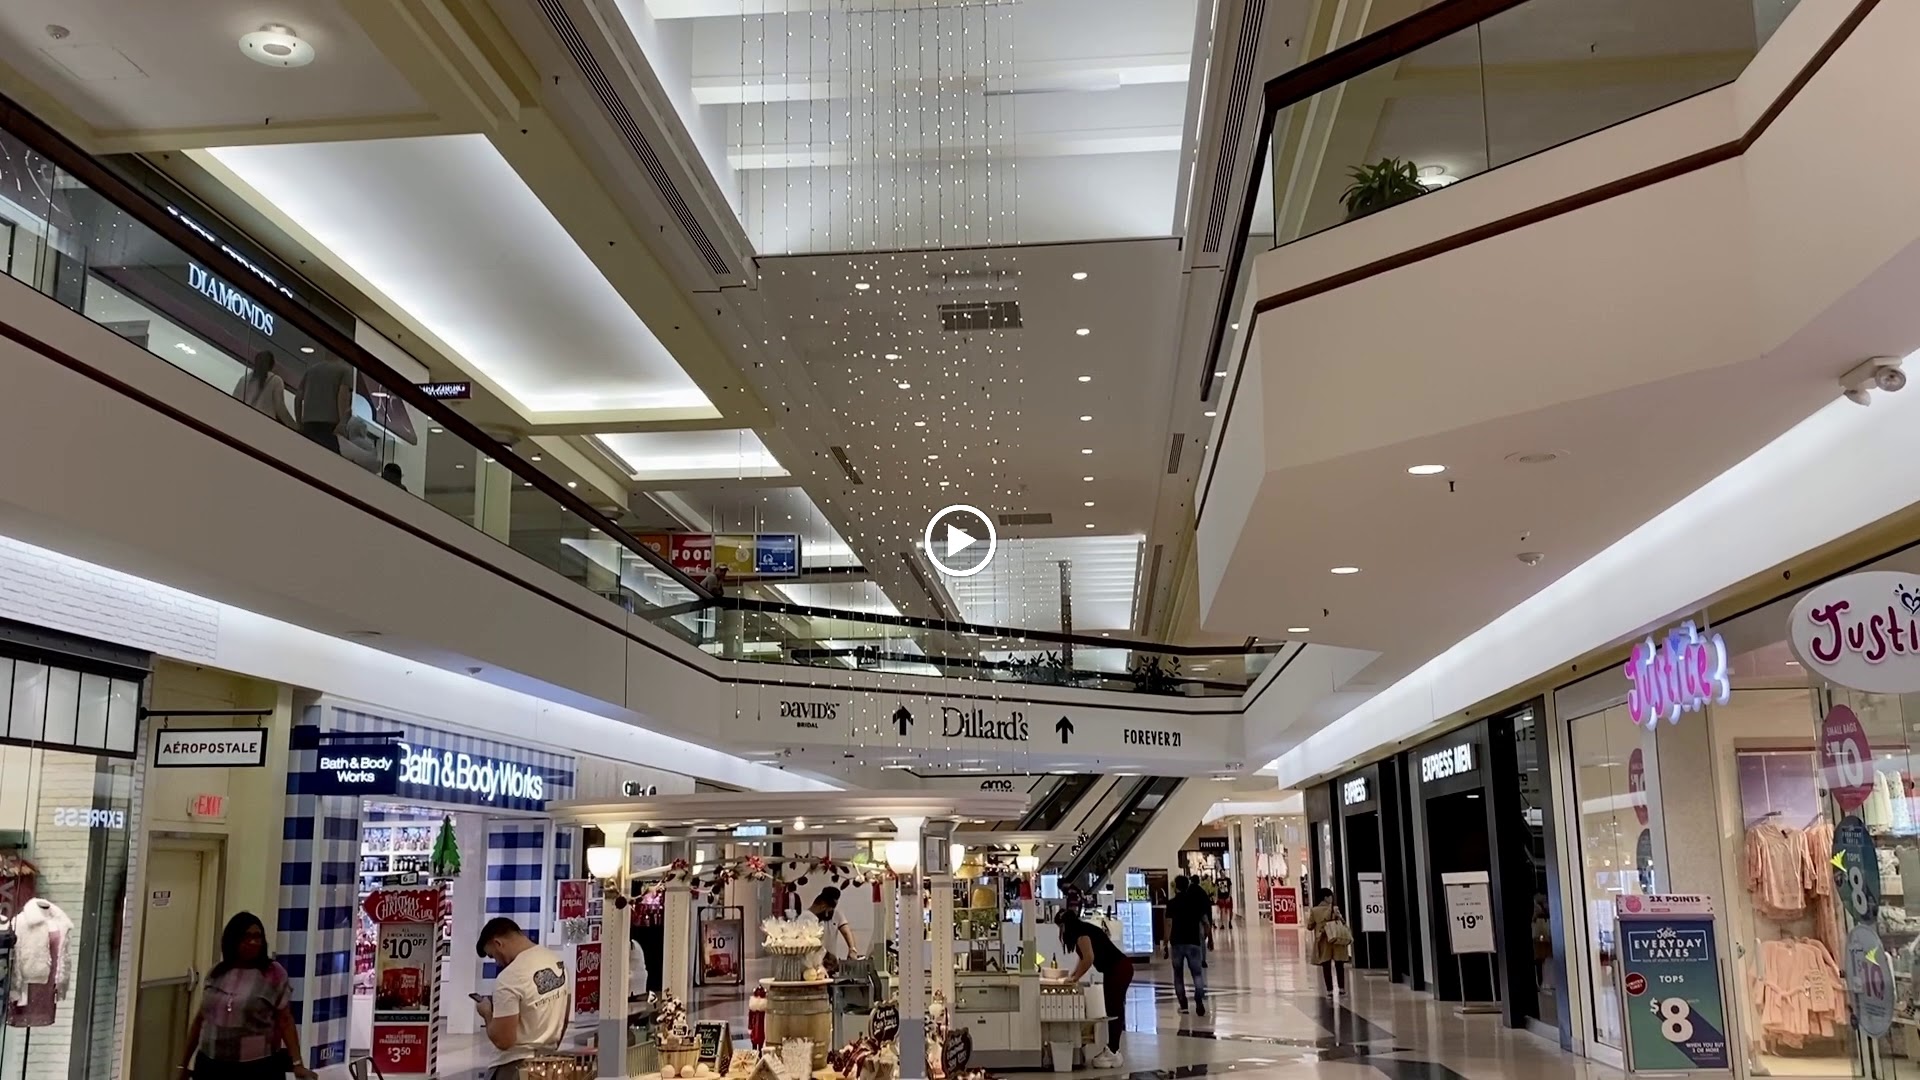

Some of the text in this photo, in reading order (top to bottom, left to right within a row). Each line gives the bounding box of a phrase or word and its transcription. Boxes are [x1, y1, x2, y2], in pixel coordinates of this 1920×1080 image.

[187, 262, 274, 336] DIAMONDS
[671, 549, 712, 561] FOOD
[1623, 629, 1715, 725] Justice
[940, 706, 1029, 741] Dillard's
[1826, 722, 1857, 737] SMALL BAGS
[1123, 729, 1182, 747] FOREVER 21
[162, 741, 258, 754] AÉROPOSTALE
[320, 757, 393, 774] Bath & Body
[1422, 742, 1472, 783] EXPRESS MEN
[1825, 738, 1864, 788] $10
[337, 770, 376, 783] Works
[397, 742, 543, 801] Bath & Body Works
[980, 780, 1012, 789] amc
[1343, 776, 1367, 806] EXPRESS
[197, 795, 223, 815] EXIT
[1847, 852, 1860, 862] TOPS
[562, 899, 583, 907] SPECIAL
[1274, 898, 1296, 913] 50%
[1667, 895, 1701, 903] POINTS
[375, 895, 420, 921] CHRISTMAS
[382, 938, 427, 959] $10 OFF
[708, 937, 726, 949] $10
[1634, 938, 1702, 950] EVERYDAY
[1649, 948, 1690, 958] FAVES
[1659, 975, 1684, 984] TOPS
[1650, 997, 1694, 1044] $8
